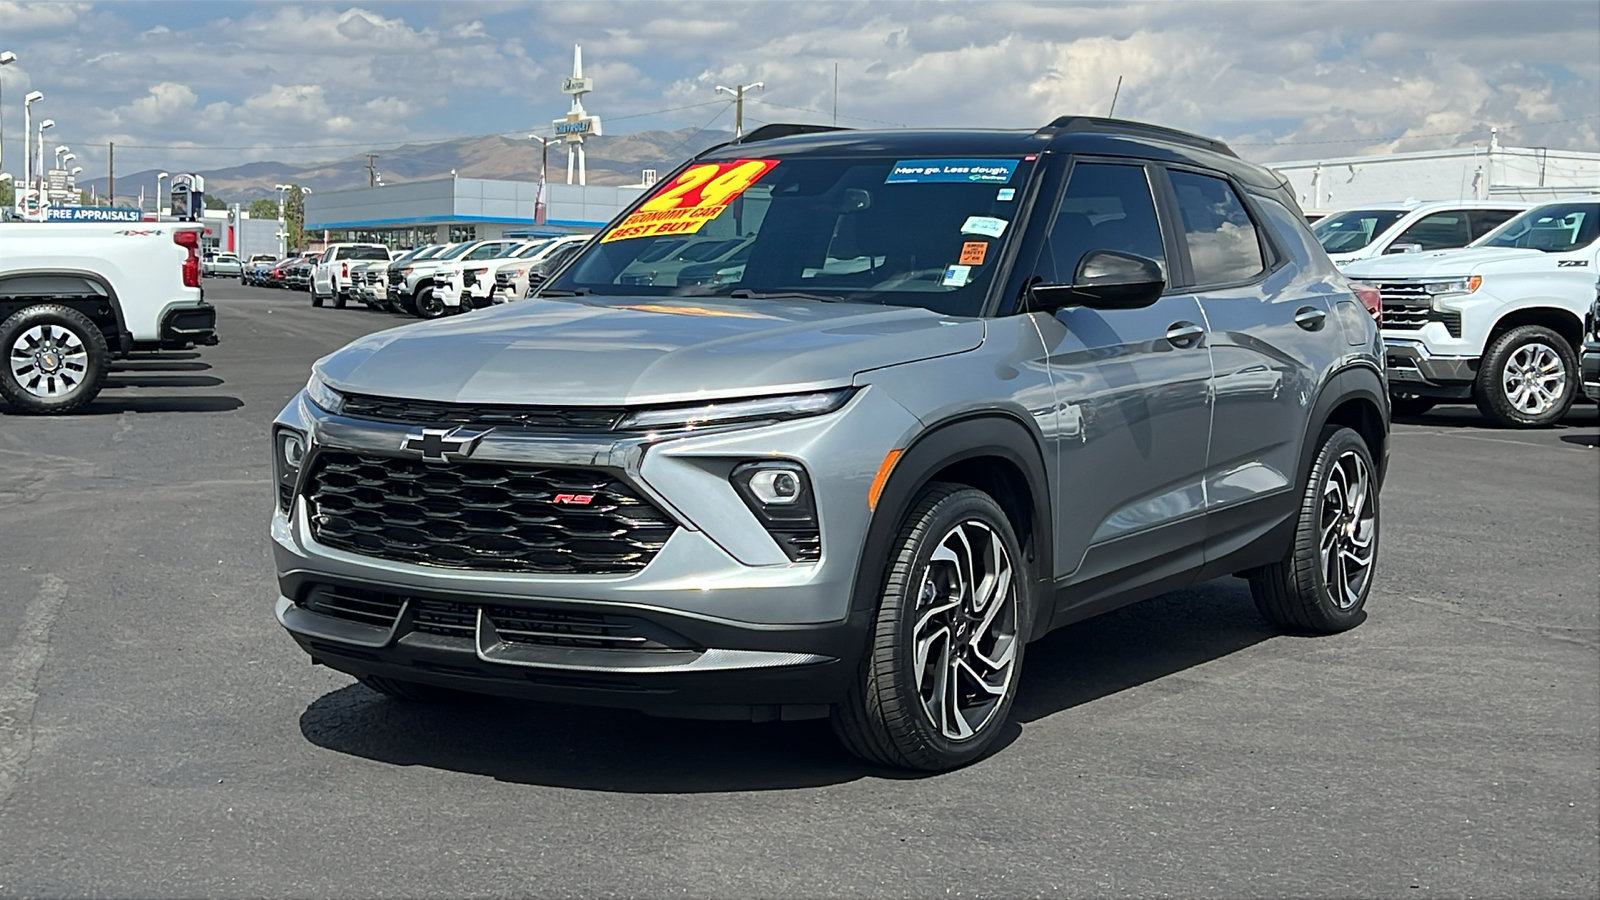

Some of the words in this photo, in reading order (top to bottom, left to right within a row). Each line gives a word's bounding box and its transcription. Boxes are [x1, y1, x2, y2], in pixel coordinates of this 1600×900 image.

[895, 166, 924, 175] More
[924, 167, 941, 176] go.
[944, 166, 969, 174] Less
[970, 166, 1009, 176] dough.
[639, 161, 767, 212] 24
[48, 209, 72, 219] FREE
[73, 210, 139, 221] APPRAISALS!
[623, 208, 689, 225] ECONOMY
[690, 206, 723, 218] CAR
[608, 224, 656, 240] BEST
[655, 220, 701, 233] BUY
[552, 493, 596, 505] RS
